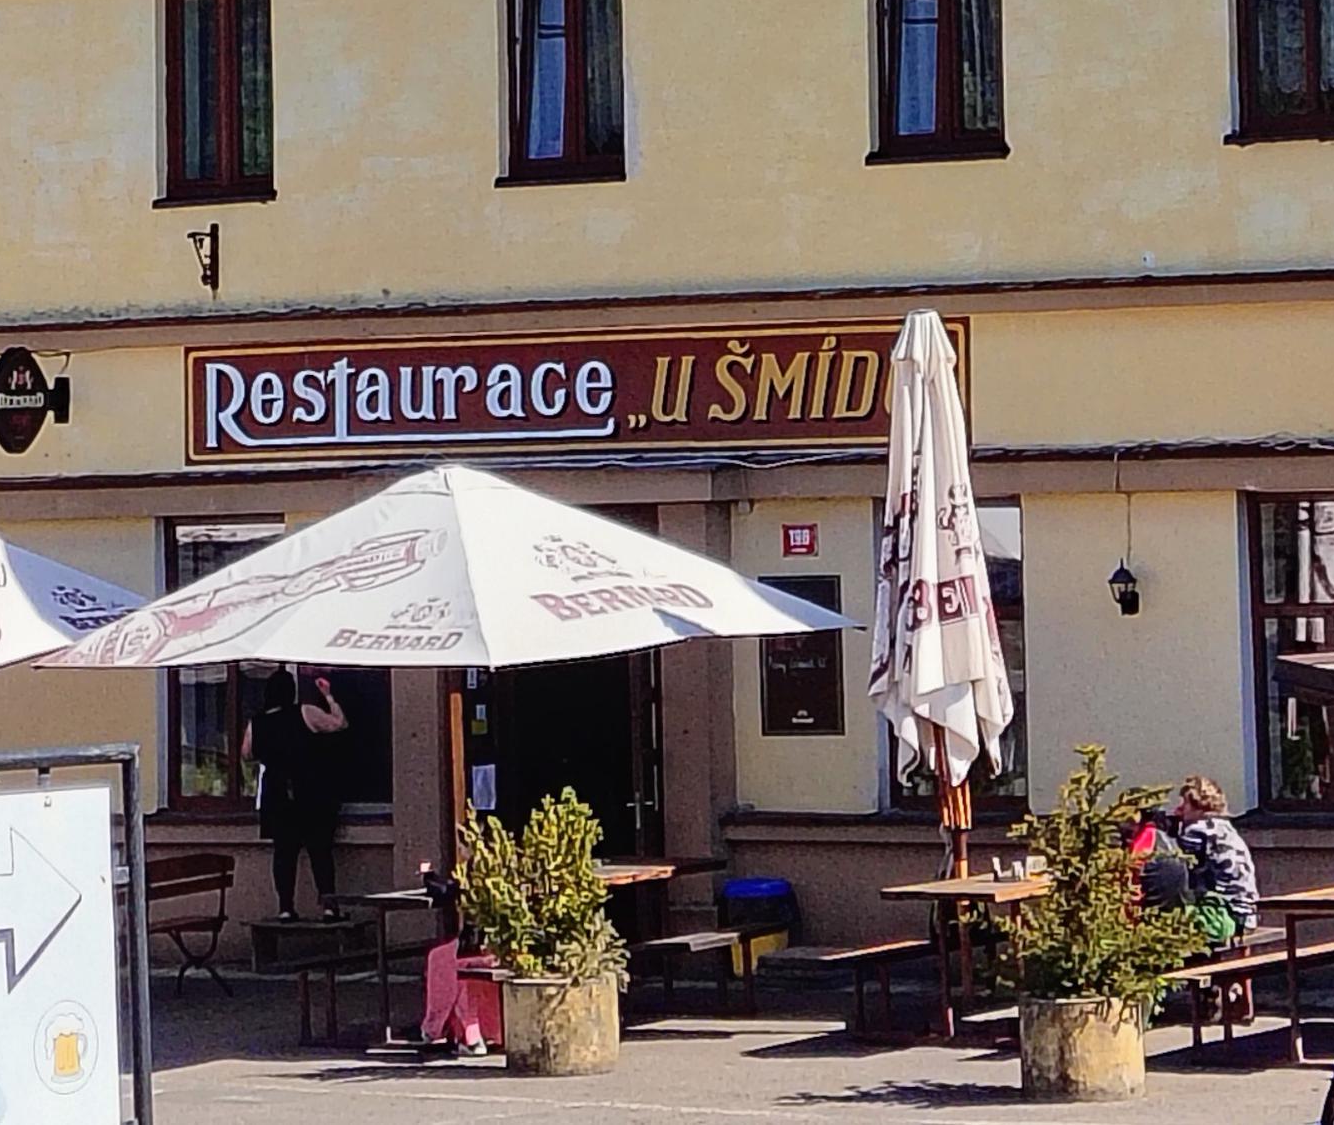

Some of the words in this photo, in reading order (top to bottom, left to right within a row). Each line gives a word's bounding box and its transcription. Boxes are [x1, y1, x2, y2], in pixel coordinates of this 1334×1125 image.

[205, 357, 616, 447] Restaurace
[707, 335, 893, 422] ŠMÍD
[529, 583, 714, 621] BERNARD
[325, 628, 464, 650] BERNARD
